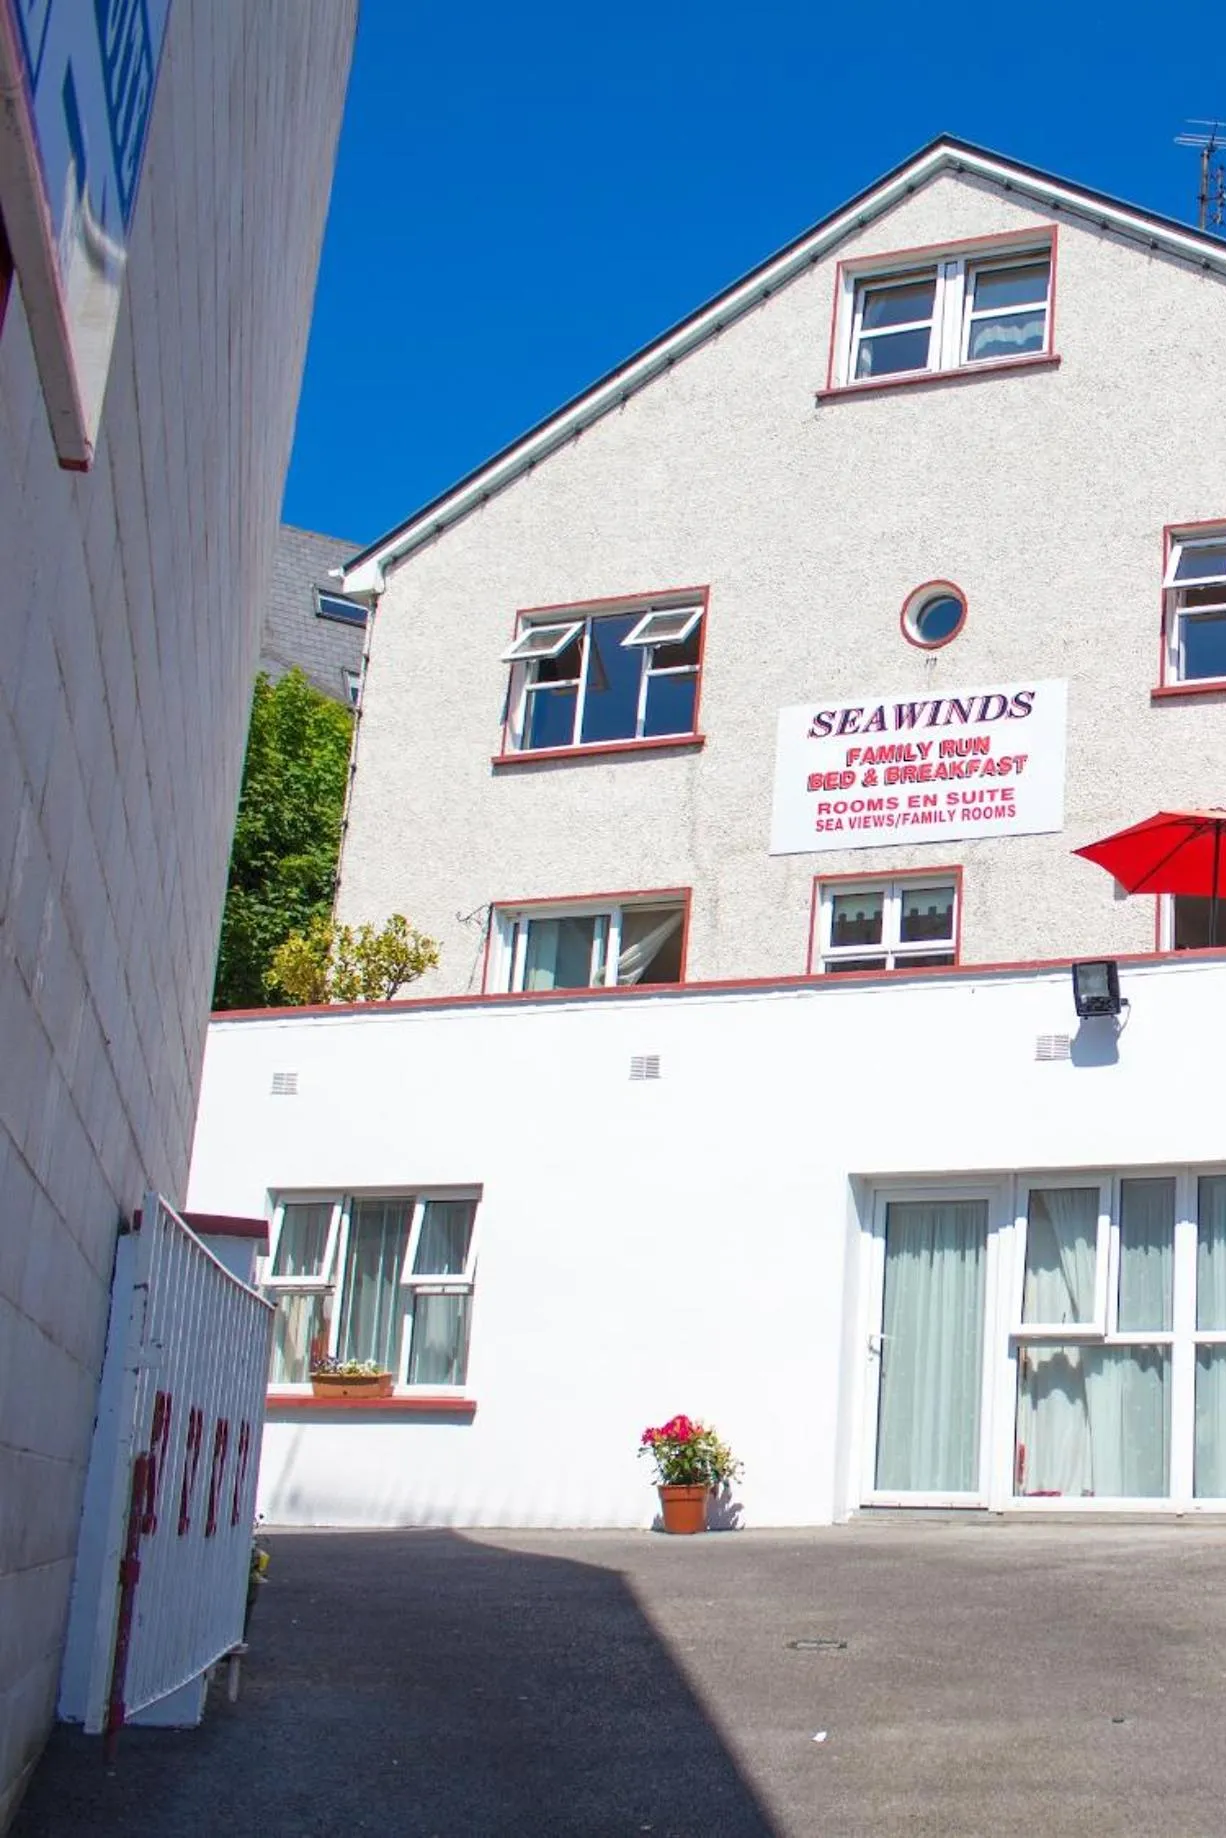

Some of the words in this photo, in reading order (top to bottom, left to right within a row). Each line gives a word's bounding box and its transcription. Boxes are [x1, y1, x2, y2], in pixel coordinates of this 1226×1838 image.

[808, 691, 1035, 738] SEAWINDS
[846, 741, 933, 767] FAMILY
[939, 736, 991, 759] RUN
[807, 770, 856, 791] BED
[861, 769, 878, 788] &
[884, 755, 1028, 784] BREAKFAST
[817, 799, 899, 815] ROOMS
[908, 795, 937, 808] EN
[946, 788, 1015, 804] SUITE
[815, 818, 843, 832] SEA
[849, 808, 955, 829] VIEWS/FAMILY
[961, 805, 1016, 821] ROOMS
